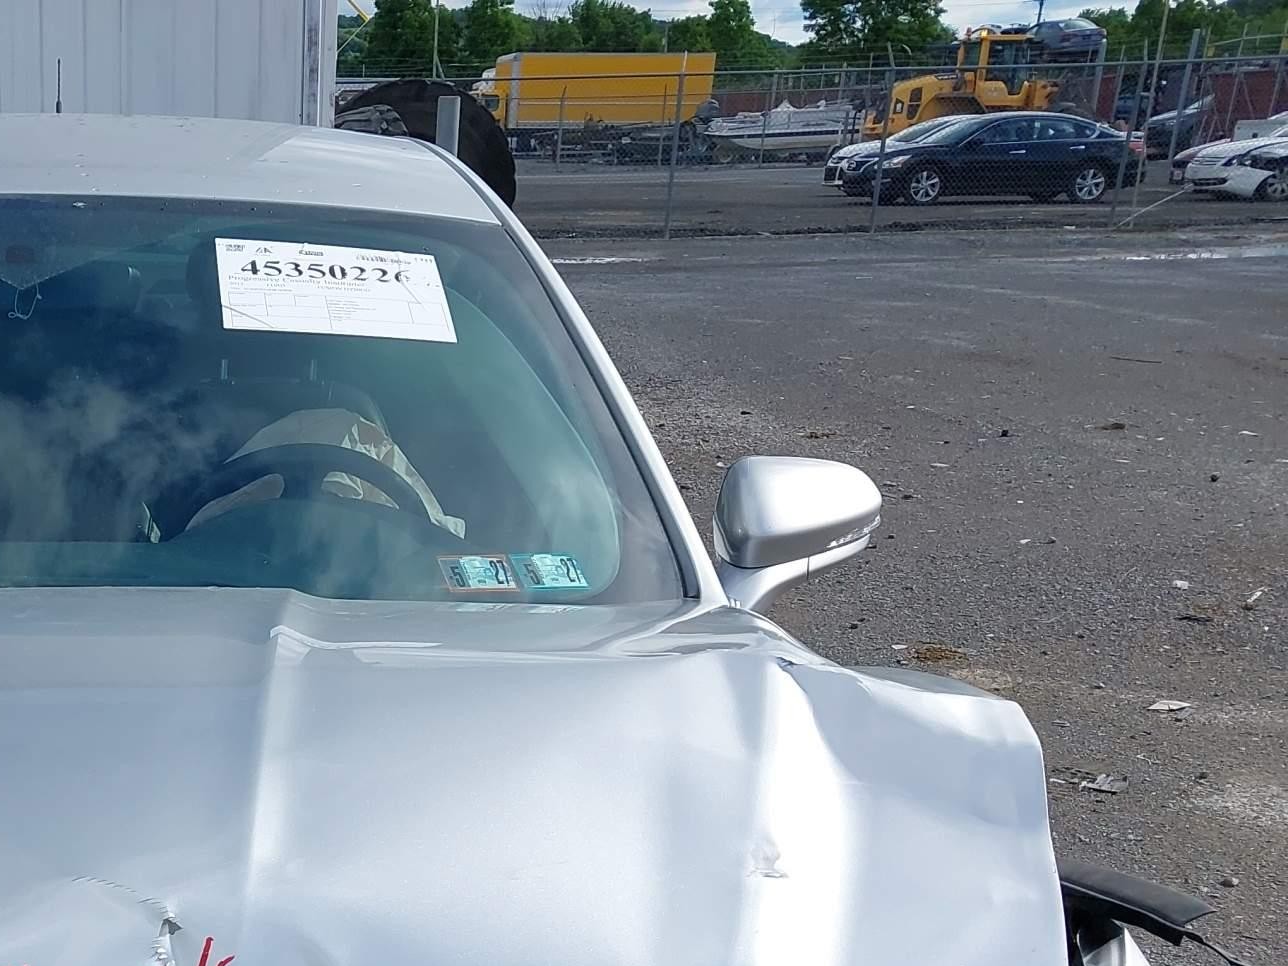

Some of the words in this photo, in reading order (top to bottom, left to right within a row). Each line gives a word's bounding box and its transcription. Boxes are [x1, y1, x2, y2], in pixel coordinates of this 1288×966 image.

[240, 259, 410, 284] 45350226
[450, 565, 466, 587] 5
[488, 559, 510, 585] 27
[523, 563, 541, 584] 5
[559, 557, 581, 583] 27
